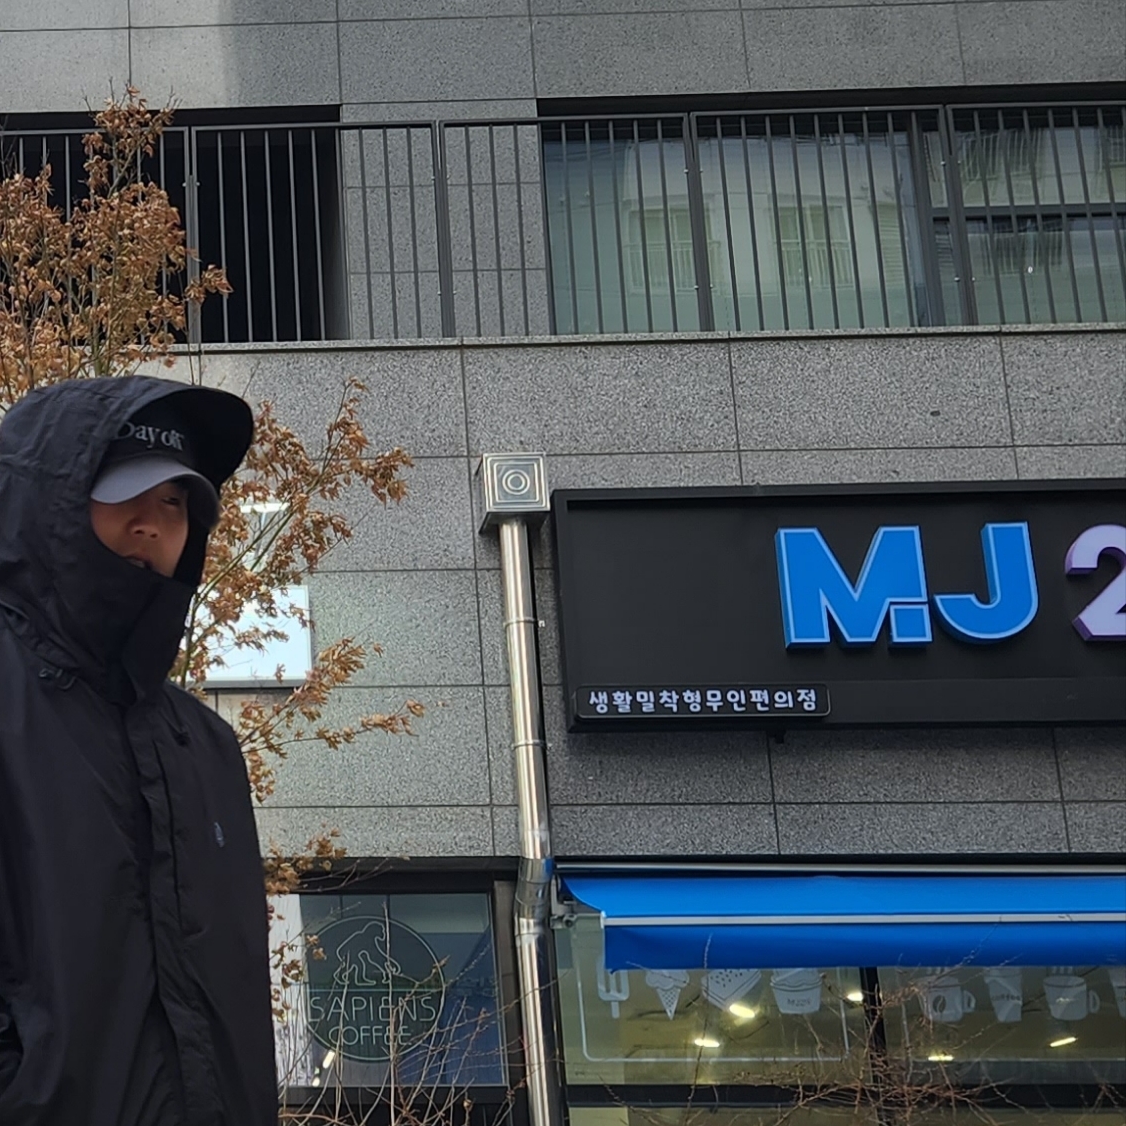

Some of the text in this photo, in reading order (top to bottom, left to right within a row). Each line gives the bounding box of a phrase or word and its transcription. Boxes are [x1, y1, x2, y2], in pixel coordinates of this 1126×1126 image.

[111, 421, 161, 449] Day
[308, 996, 437, 1022] SAPIENS
[328, 1025, 413, 1046] COFFEE
